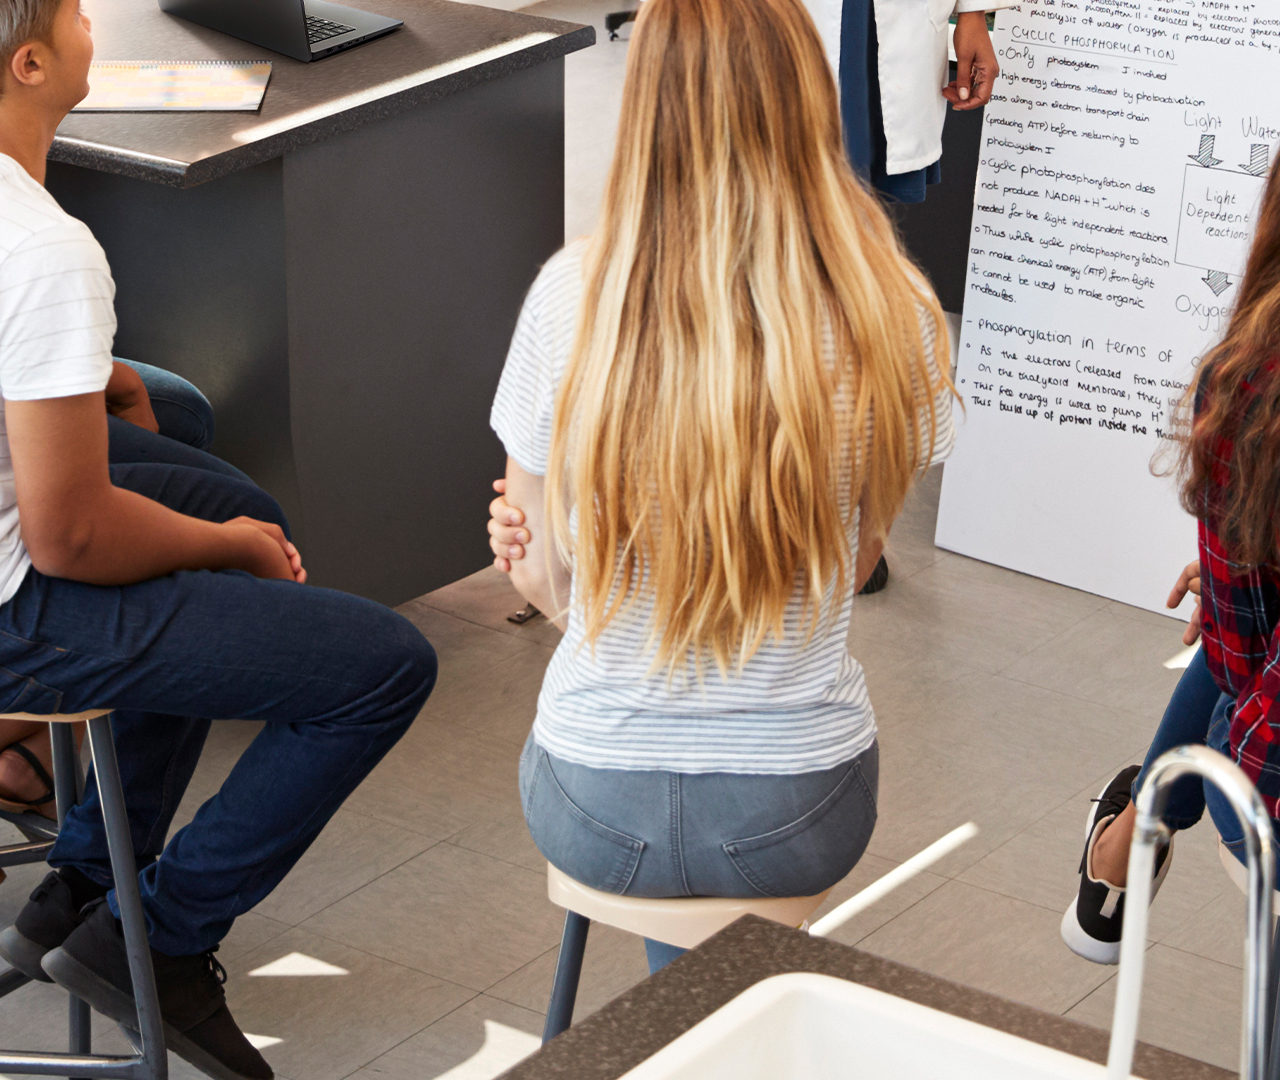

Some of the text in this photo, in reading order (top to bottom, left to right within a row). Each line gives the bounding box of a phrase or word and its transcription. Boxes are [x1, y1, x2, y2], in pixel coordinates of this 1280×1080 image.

[1011, 26, 1176, 60] CYCLIC PHOSPHORYLATION
[1006, 48, 1168, 81] Only photosystem I involved
[1001, 70, 1020, 84] high
[1022, 76, 1047, 90] energy
[1050, 78, 1082, 91] electrons
[1085, 84, 1118, 97] released
[1123, 90, 1134, 104] by
[1184, 110, 1222, 133] Light
[986, 137, 1055, 155] photosystem I
[988, 158, 1156, 194] Cyclic photophosphorylation does
[1205, 187, 1236, 206] Light
[1186, 202, 1250, 224] Dependent
[1204, 224, 1248, 240] reactions
[1082, 337, 1094, 350] in
[1106, 338, 1146, 357] terms
[1158, 350, 1173, 362] of
[980, 345, 991, 355] As
[1001, 350, 1018, 360] the
[1025, 355, 1071, 367] electrons
[1134, 374, 1156, 386] from
